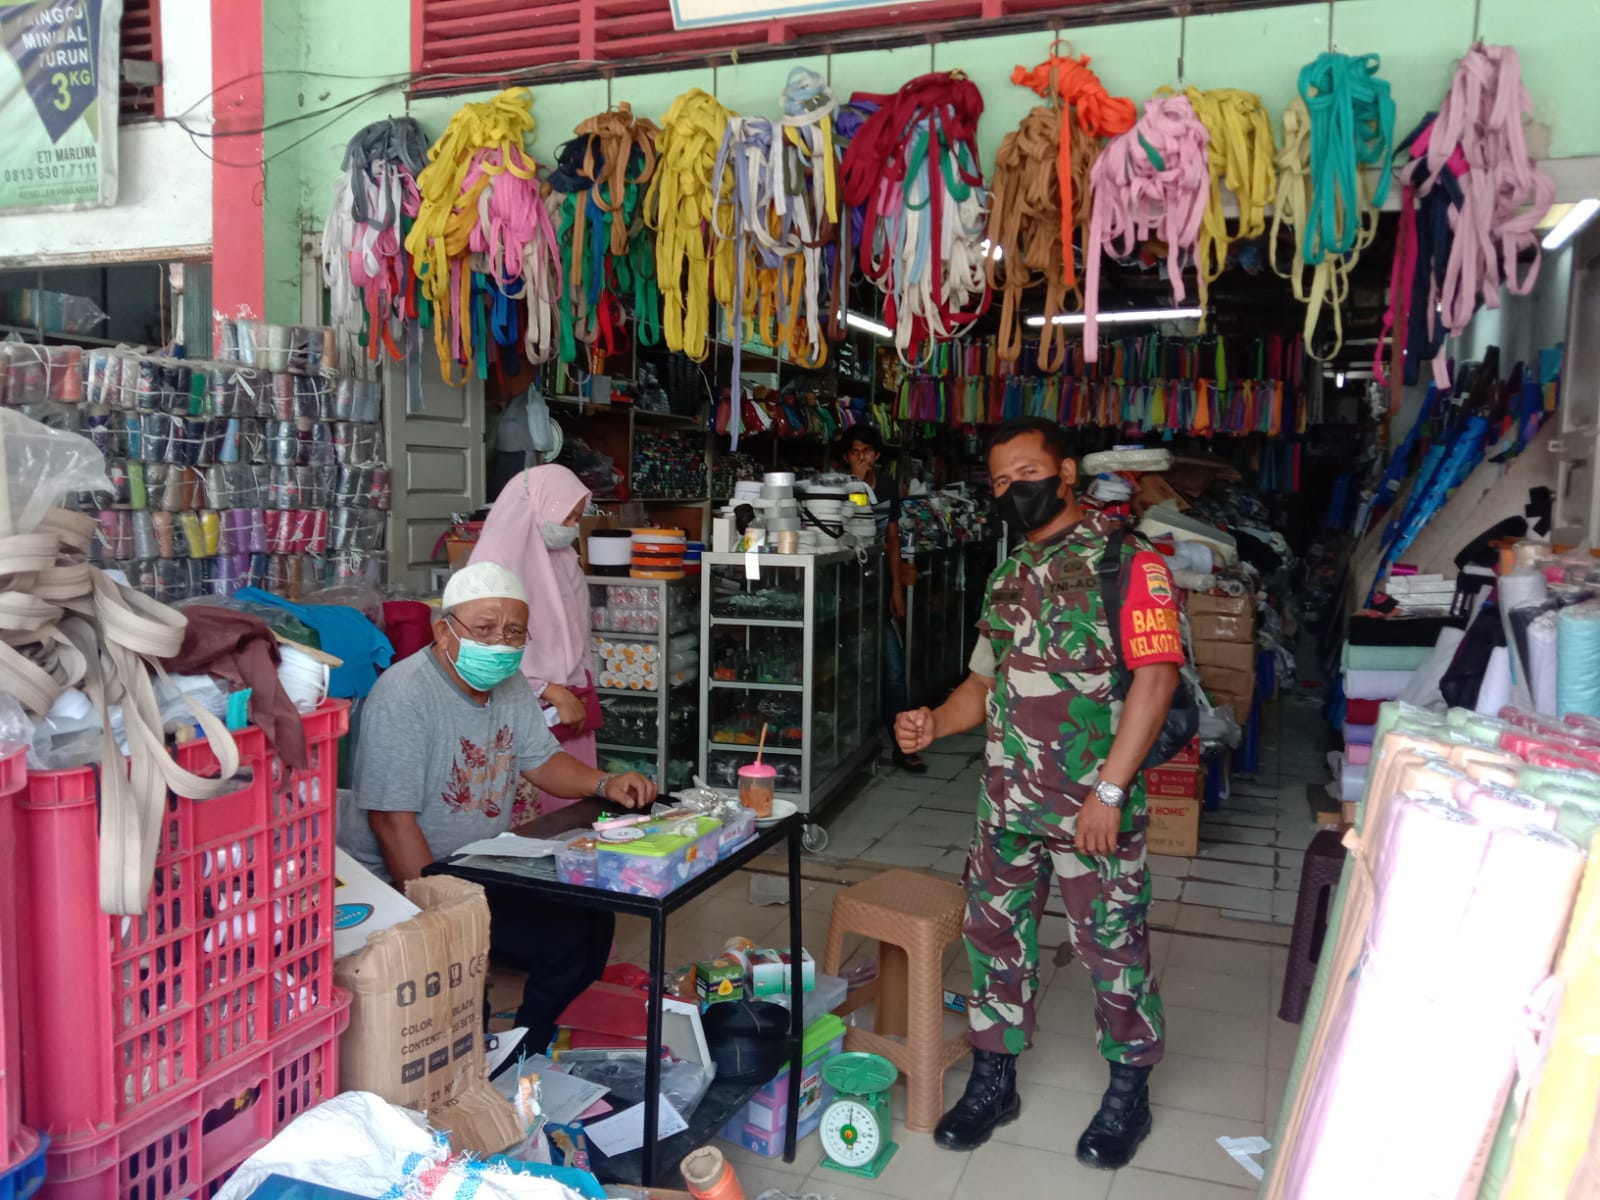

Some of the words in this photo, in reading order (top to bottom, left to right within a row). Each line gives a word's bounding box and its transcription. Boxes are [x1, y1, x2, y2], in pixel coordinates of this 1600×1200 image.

[31, 6, 83, 25] INGGU
[40, 48, 89, 68] TURUN
[51, 72, 71, 111] 3
[69, 69, 91, 86] KG
[37, 150, 52, 164] ETI
[55, 145, 97, 162] MARLINA
[4, 168, 34, 183] 0813
[37, 164, 66, 180] 6307
[1155, 807, 1185, 817] HOME
[400, 1018, 432, 1037] COLOR
